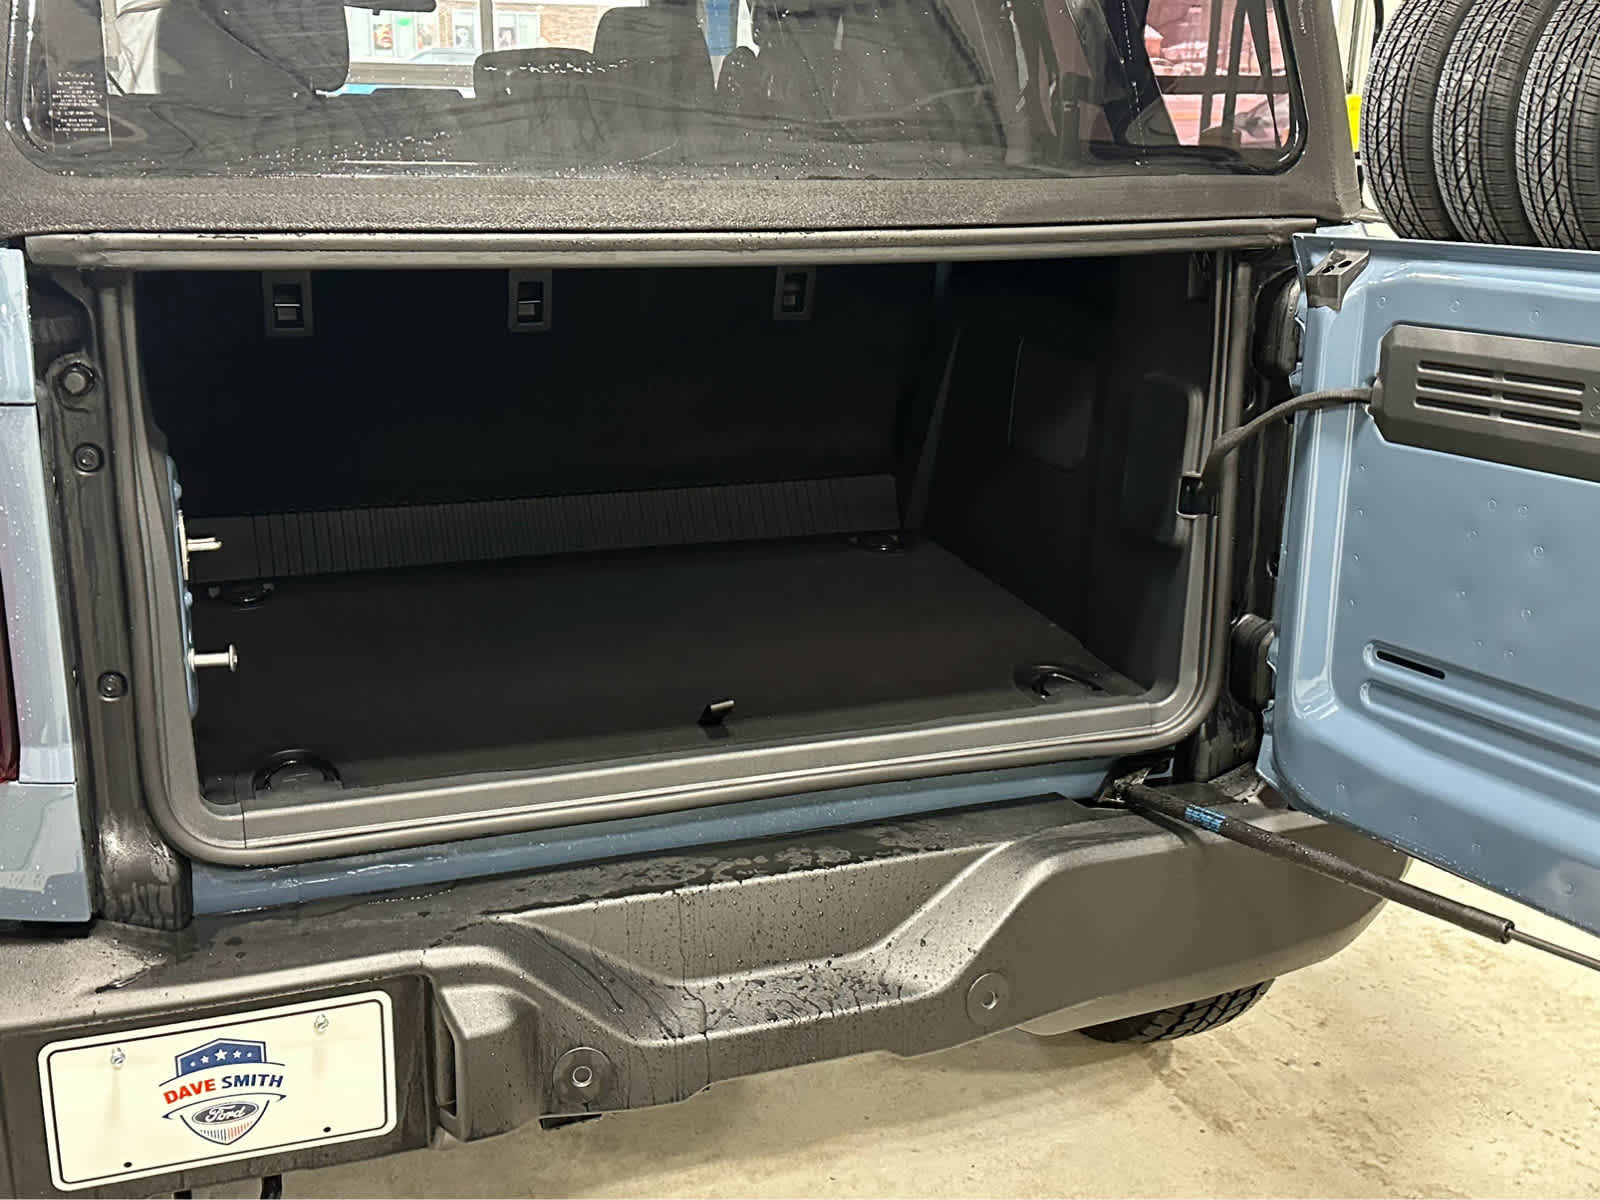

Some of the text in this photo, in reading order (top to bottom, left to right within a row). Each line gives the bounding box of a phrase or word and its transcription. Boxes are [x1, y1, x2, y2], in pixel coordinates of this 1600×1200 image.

[163, 1074, 283, 1104] DAVE SMITH
[205, 1104, 245, 1122] Ford
